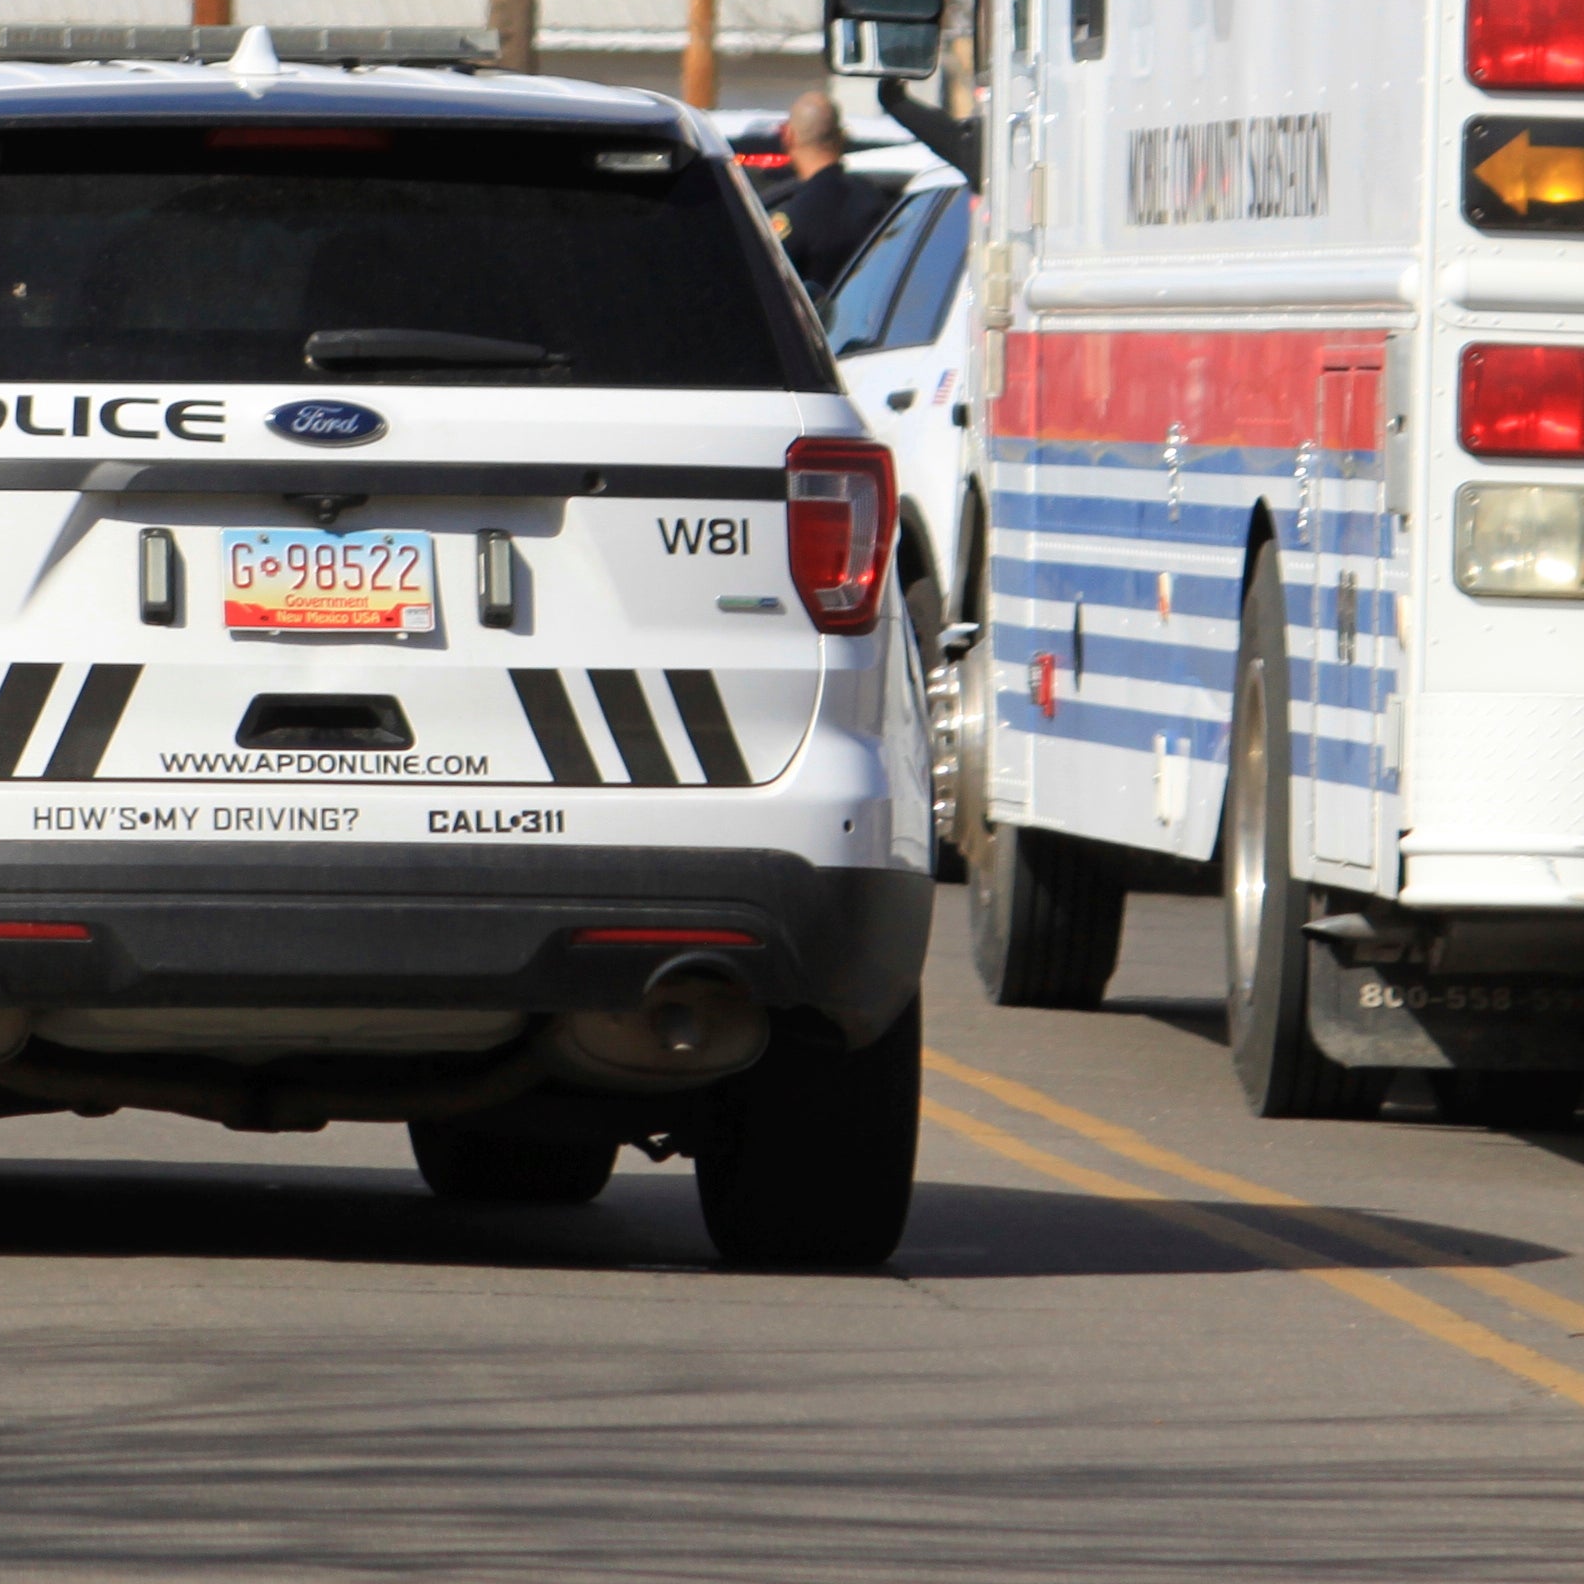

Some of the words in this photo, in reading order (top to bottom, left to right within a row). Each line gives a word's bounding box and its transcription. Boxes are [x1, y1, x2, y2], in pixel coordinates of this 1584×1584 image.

[291, 404, 361, 433] Ford
[285, 593, 369, 608] Government
[276, 610, 303, 623] New
[306, 610, 348, 624] Mexico
[352, 611, 381, 624] USA
[160, 752, 489, 776] WWW.APDONLINE.COM
[213, 807, 360, 832] DRIVING?
